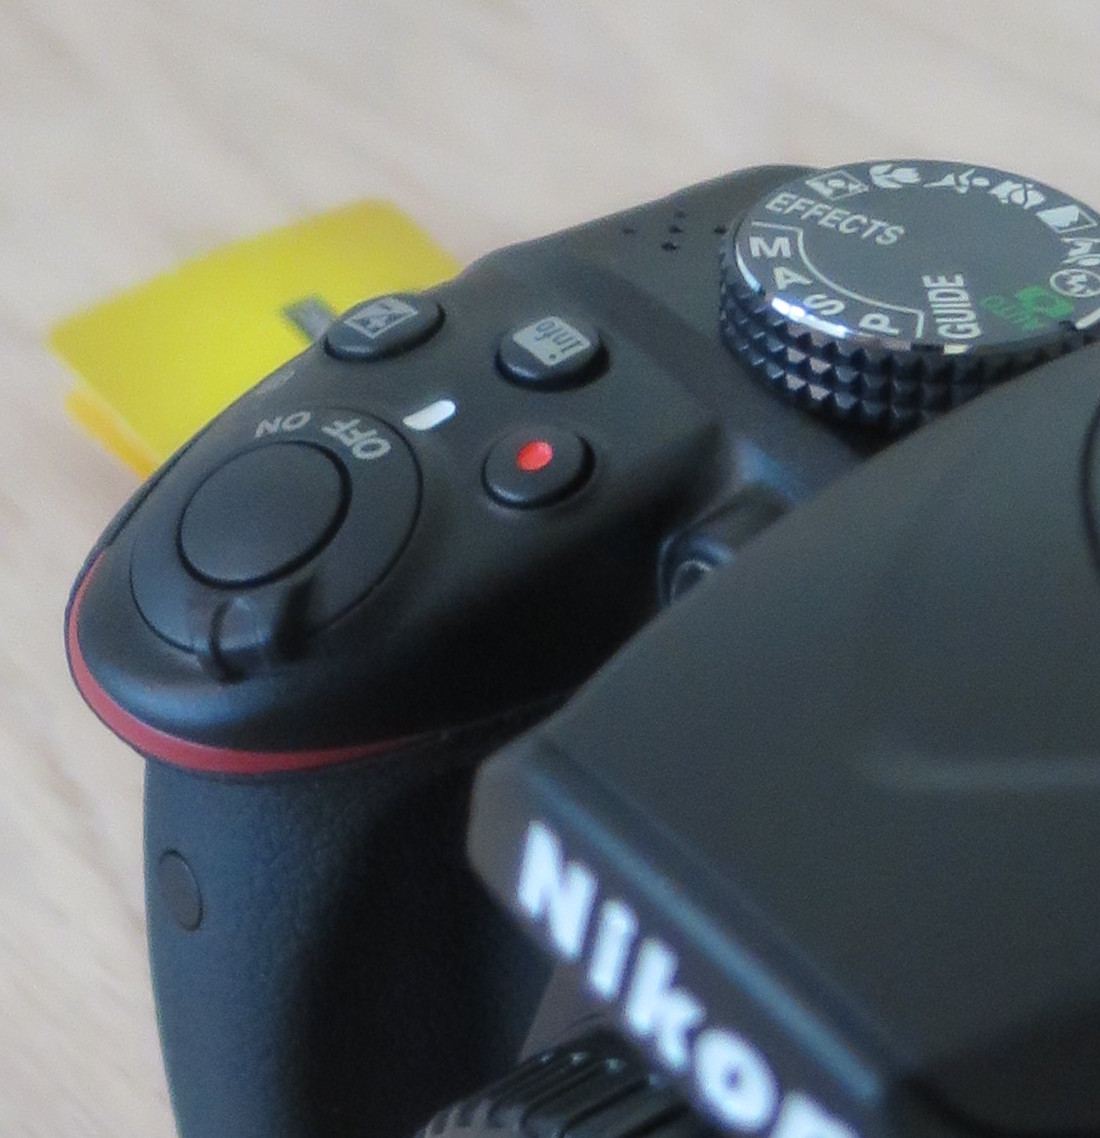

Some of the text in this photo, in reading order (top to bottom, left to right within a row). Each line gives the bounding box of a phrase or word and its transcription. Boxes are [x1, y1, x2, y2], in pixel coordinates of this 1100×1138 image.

[765, 192, 904, 246] EFFECTS
[749, 236, 792, 259] M
[774, 266, 813, 291] A
[804, 294, 845, 317] S
[922, 274, 983, 340] GUIDE
[858, 314, 899, 335] P
[254, 411, 311, 438] ON
[322, 417, 392, 460] OFF
